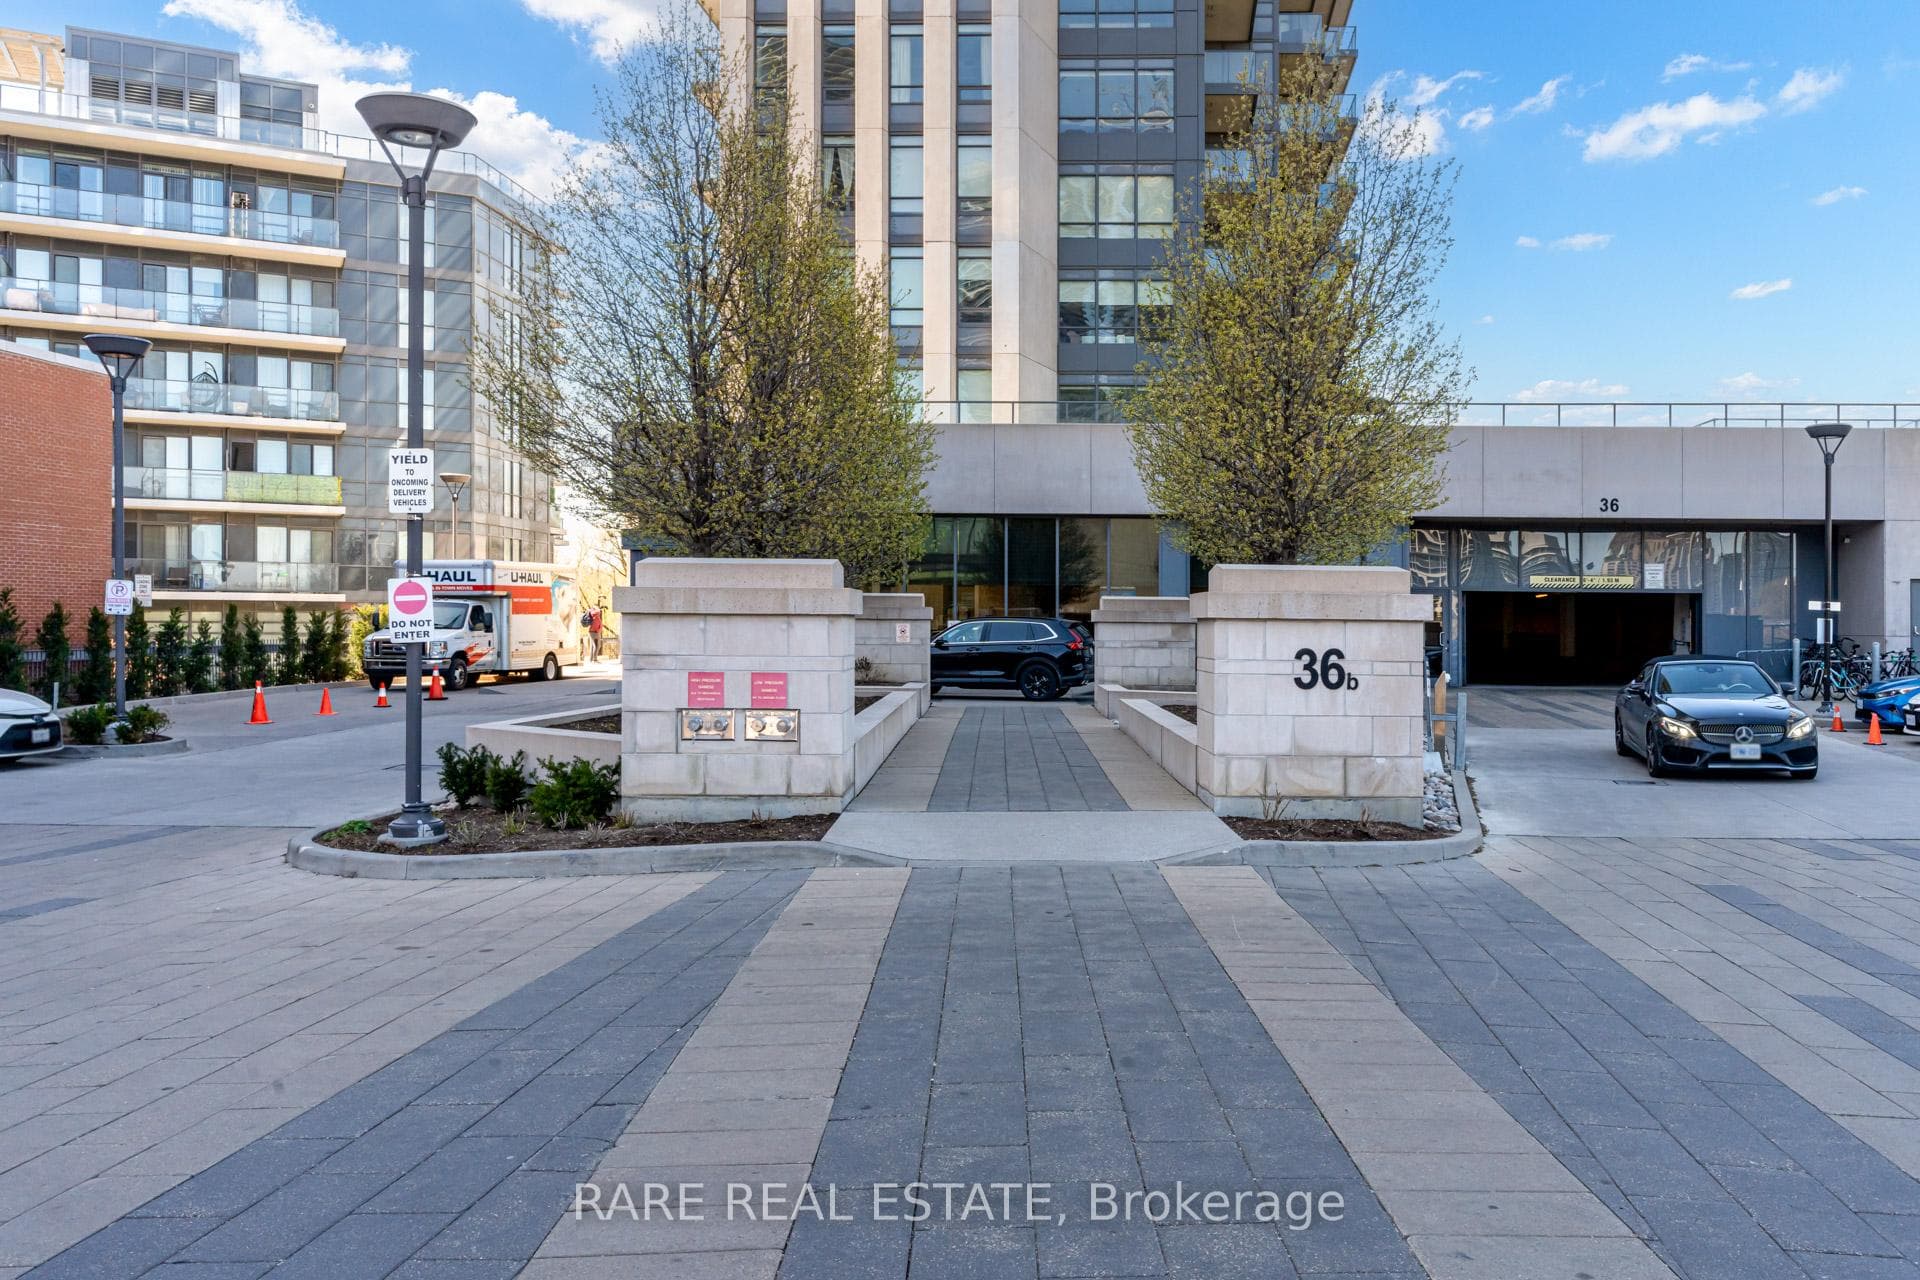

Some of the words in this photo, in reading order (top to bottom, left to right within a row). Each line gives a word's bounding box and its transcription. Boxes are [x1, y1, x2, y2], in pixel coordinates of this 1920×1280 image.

[391, 455, 429, 464] YIELD
[405, 468, 415, 476] TO
[391, 478, 429, 486] ONCOMING
[1599, 498, 1620, 512] 36
[510, 572, 544, 584] U-HAUL
[391, 620, 408, 629] DO
[409, 619, 432, 628] NOT
[394, 631, 431, 640] ENTER
